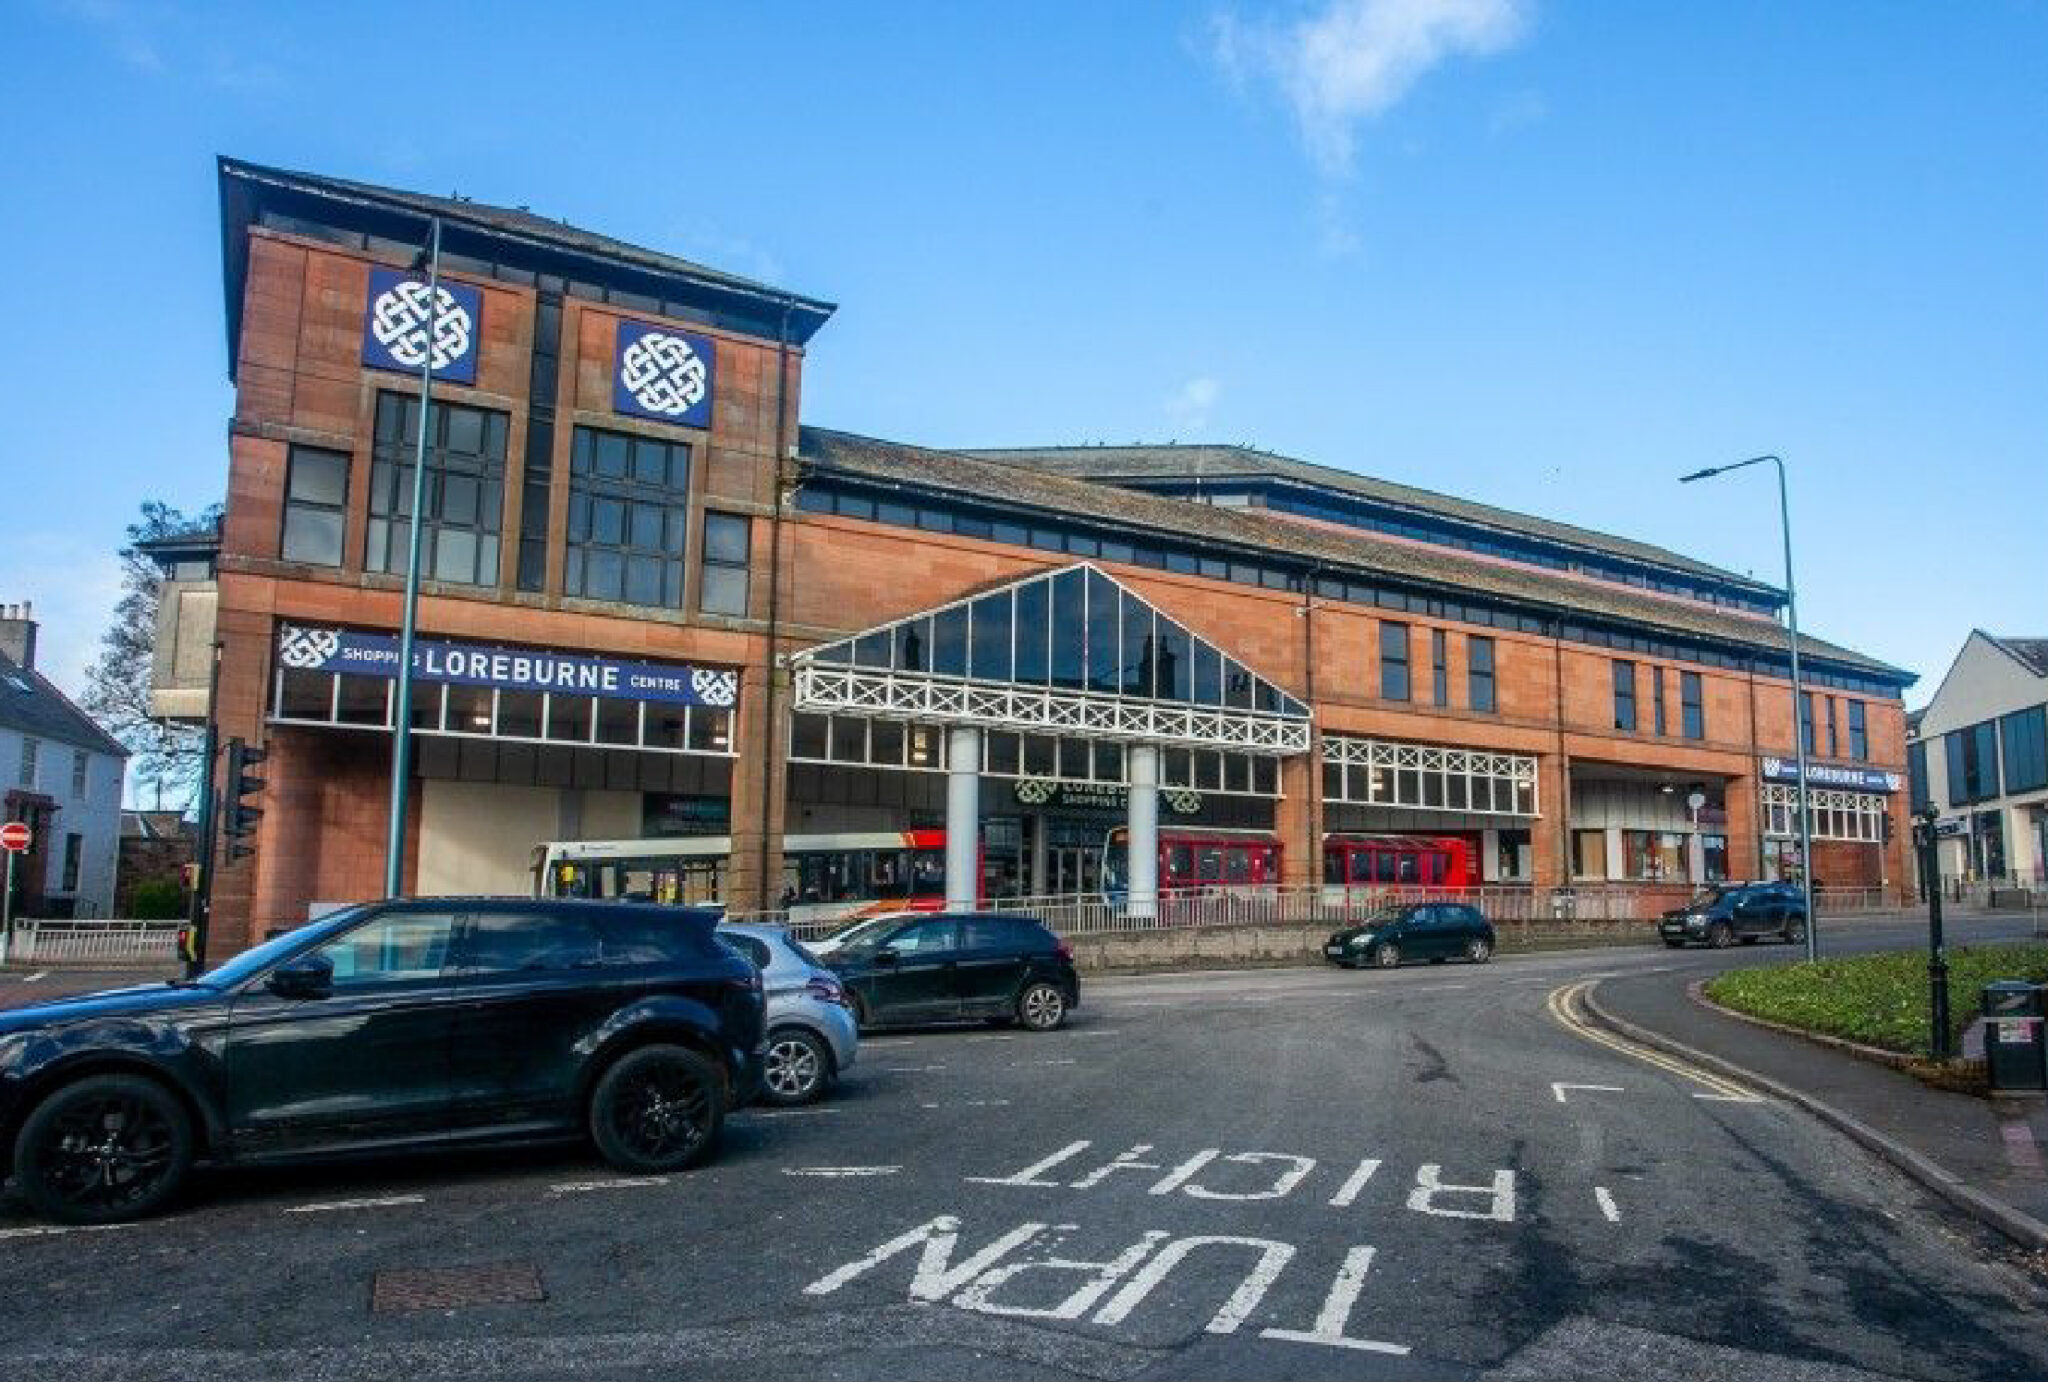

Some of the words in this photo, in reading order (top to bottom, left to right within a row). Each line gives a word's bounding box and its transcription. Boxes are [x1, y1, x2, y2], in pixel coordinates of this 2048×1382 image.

[341, 647, 421, 667] SHOPPIG
[426, 651, 620, 691] LOREBURNE
[629, 675, 682, 691] CENTRE
[801, 1215, 1412, 1355] TURN
